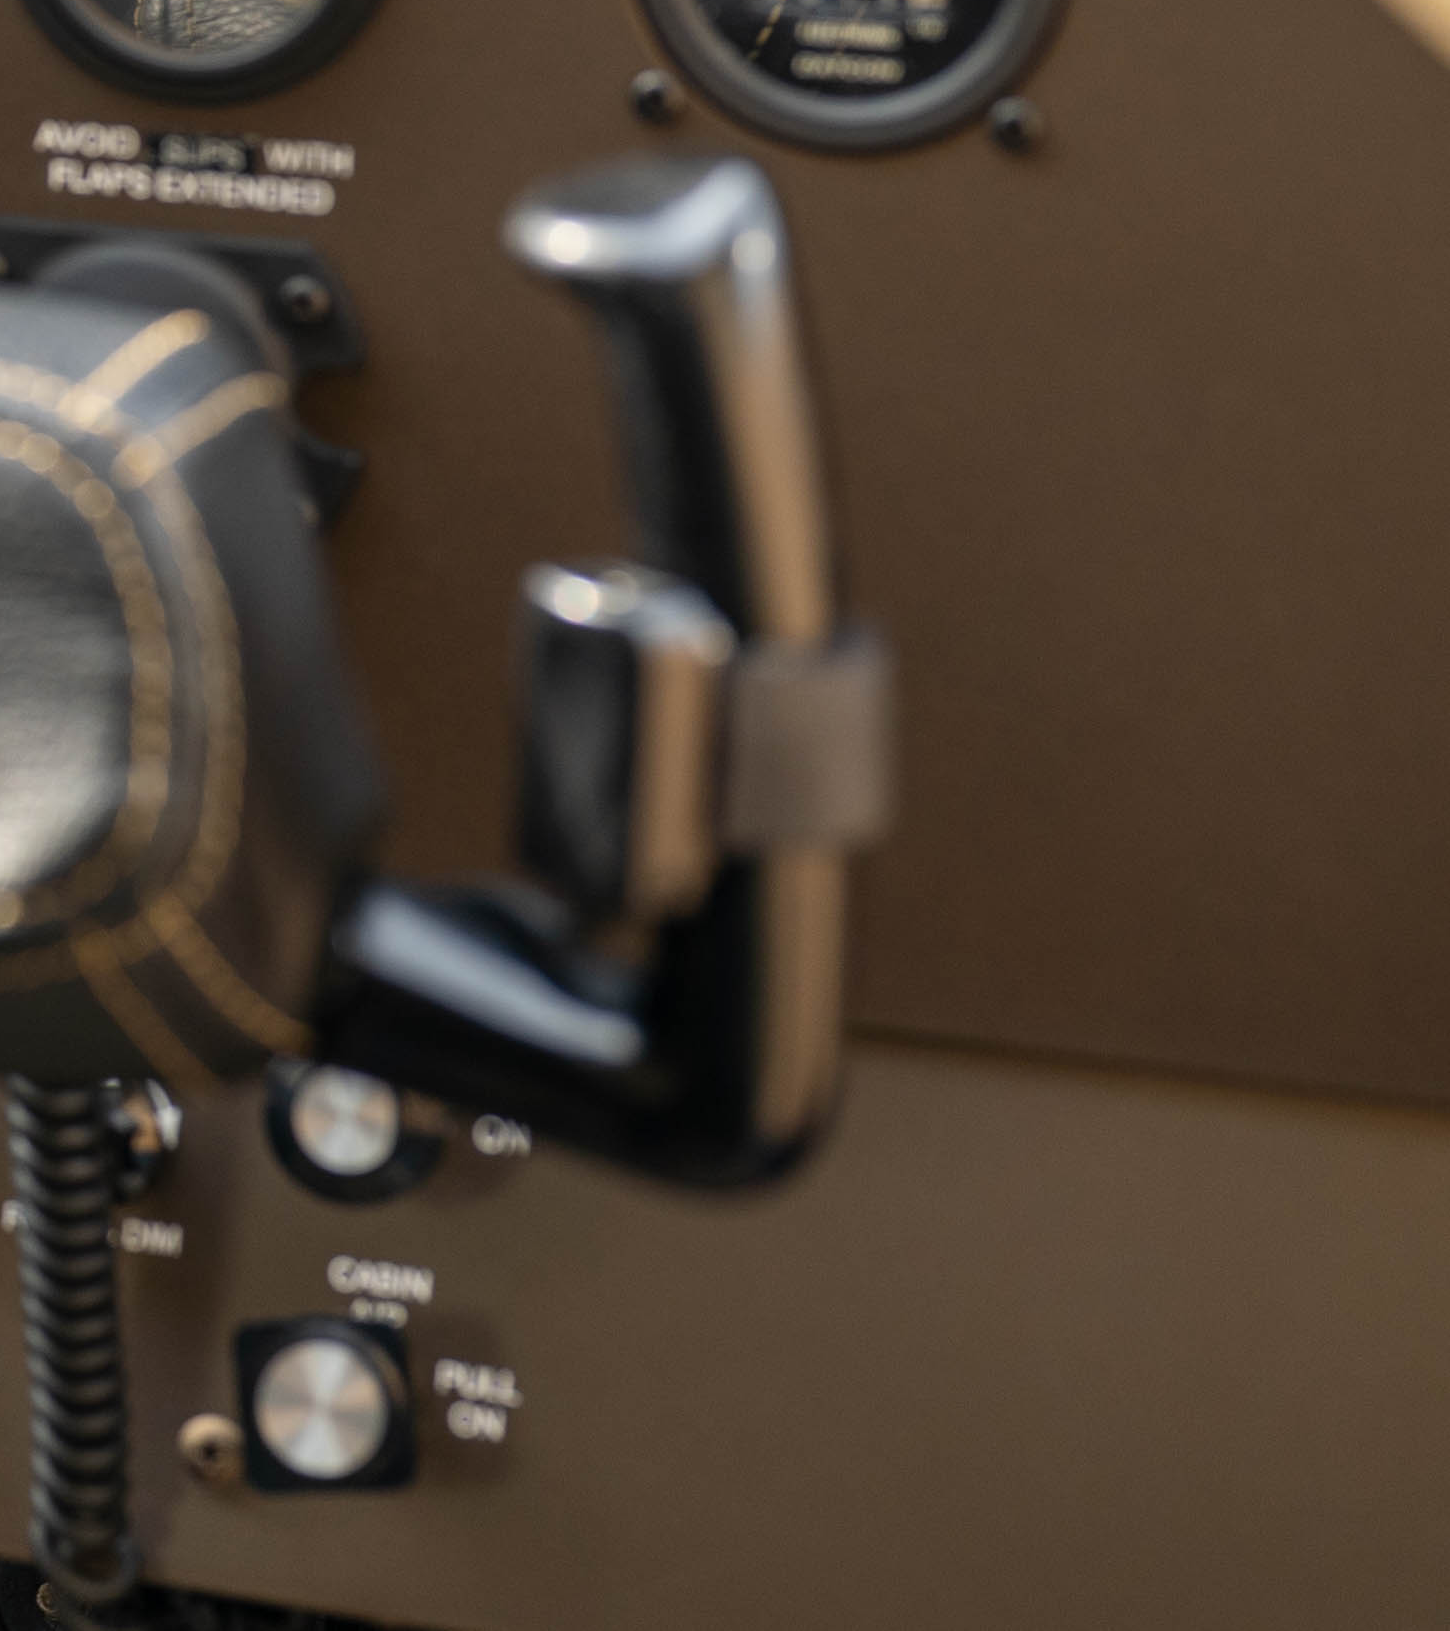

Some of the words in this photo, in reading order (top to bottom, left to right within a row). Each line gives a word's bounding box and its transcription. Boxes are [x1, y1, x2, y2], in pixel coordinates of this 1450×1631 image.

[47, 156, 152, 200] FLAPS
[262, 139, 356, 178] WITH
[327, 1255, 434, 1305] CABIN
[434, 1359, 523, 1408] PULL
[447, 1401, 508, 1444] ON
